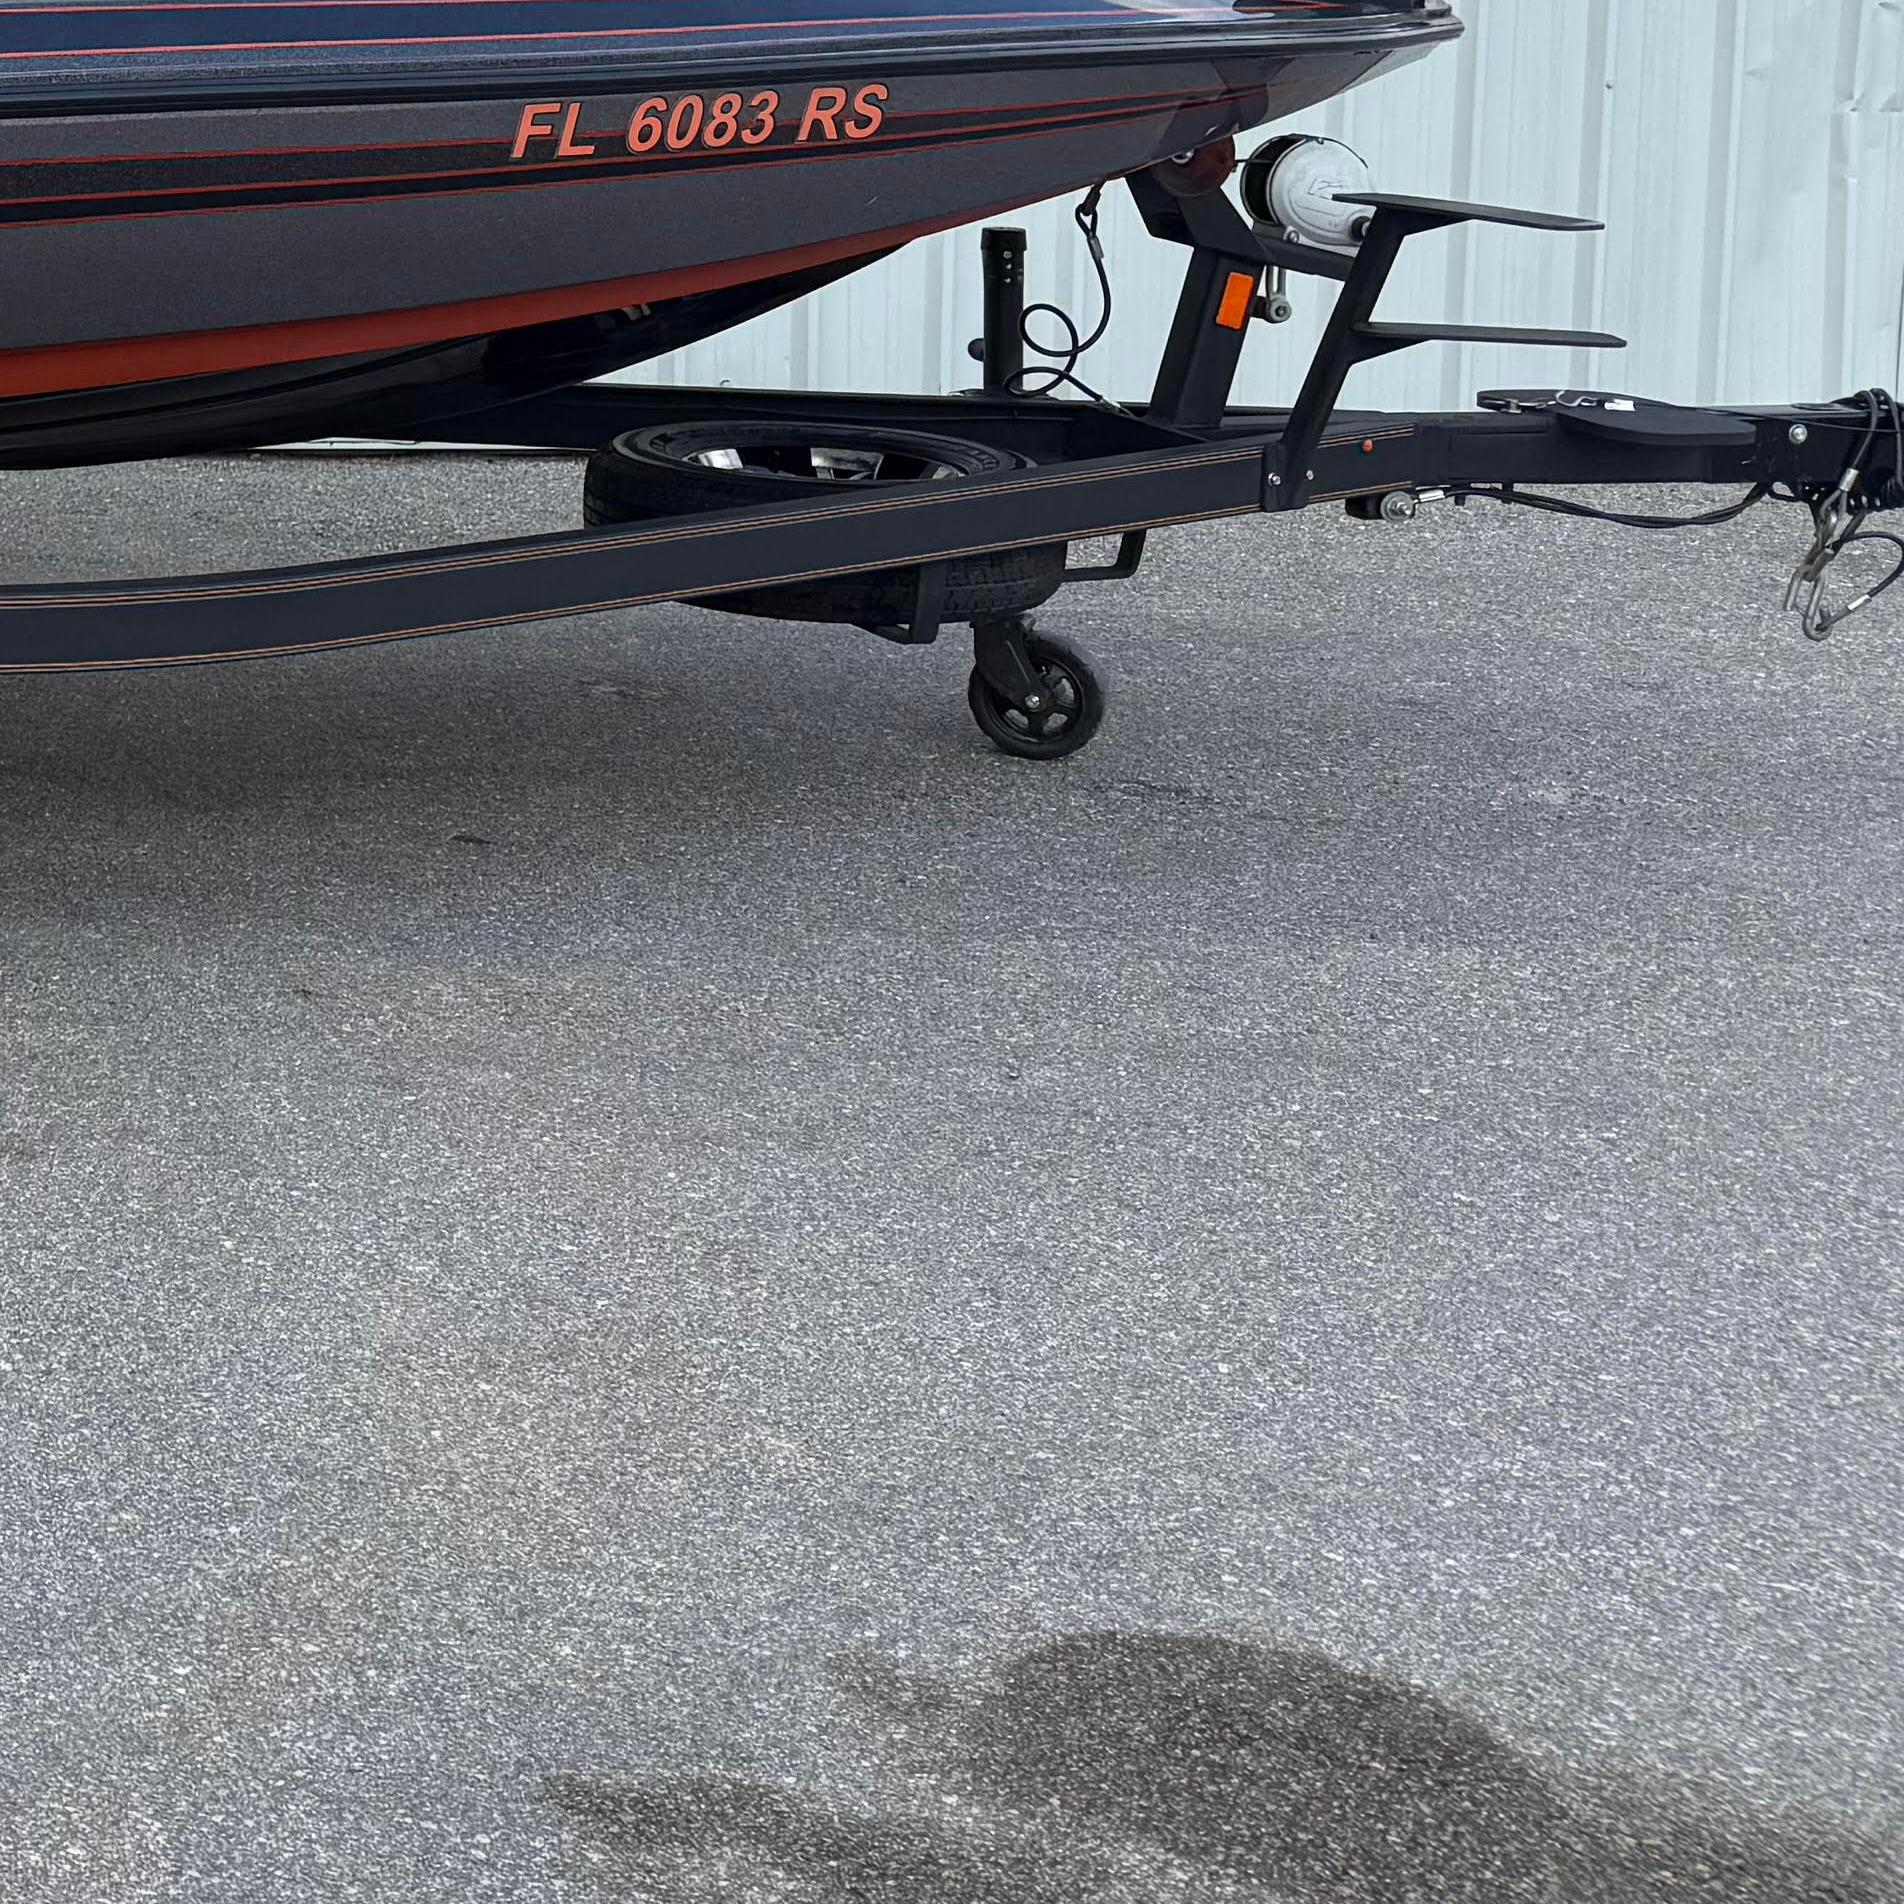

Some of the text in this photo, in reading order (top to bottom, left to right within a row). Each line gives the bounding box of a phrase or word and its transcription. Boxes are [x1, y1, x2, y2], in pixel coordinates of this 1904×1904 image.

[510, 82, 889, 159] FL 6083 RS
